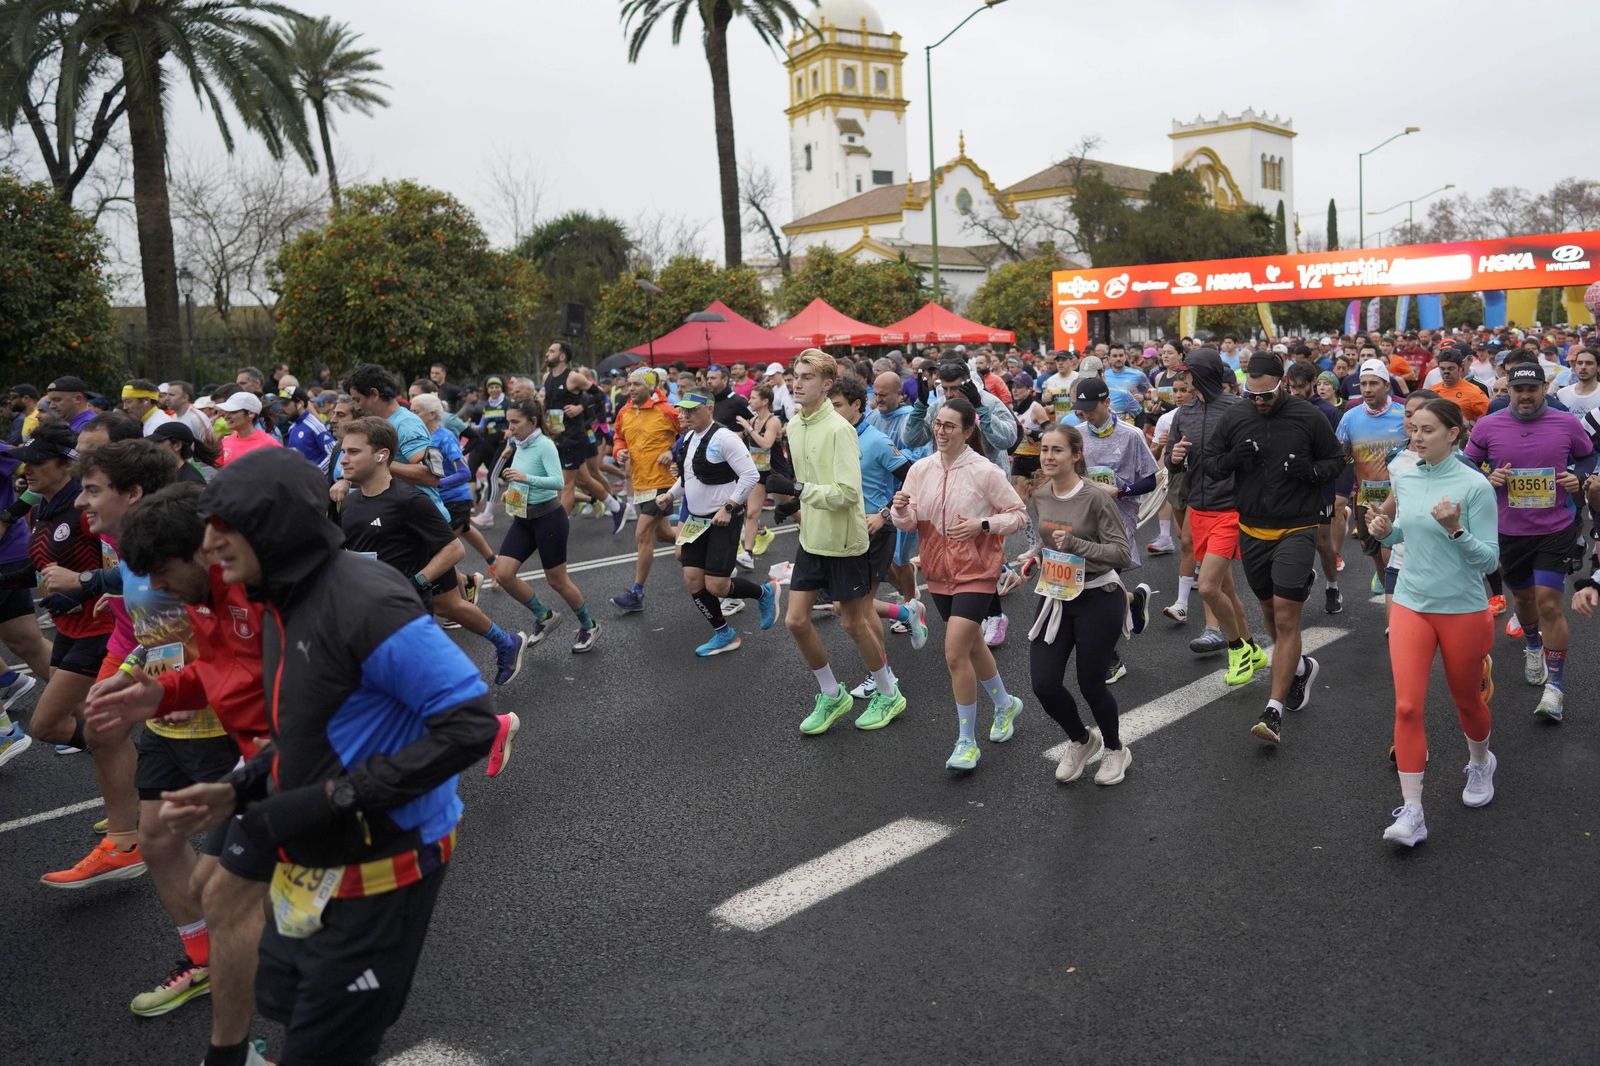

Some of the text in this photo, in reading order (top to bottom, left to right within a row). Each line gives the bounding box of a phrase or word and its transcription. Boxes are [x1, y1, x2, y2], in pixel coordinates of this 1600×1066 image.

[1478, 252, 1536, 272] HOKA
[1514, 369, 1536, 378] HOKA
[1511, 478, 1548, 491] 13561
[1045, 561, 1072, 581] 7100
